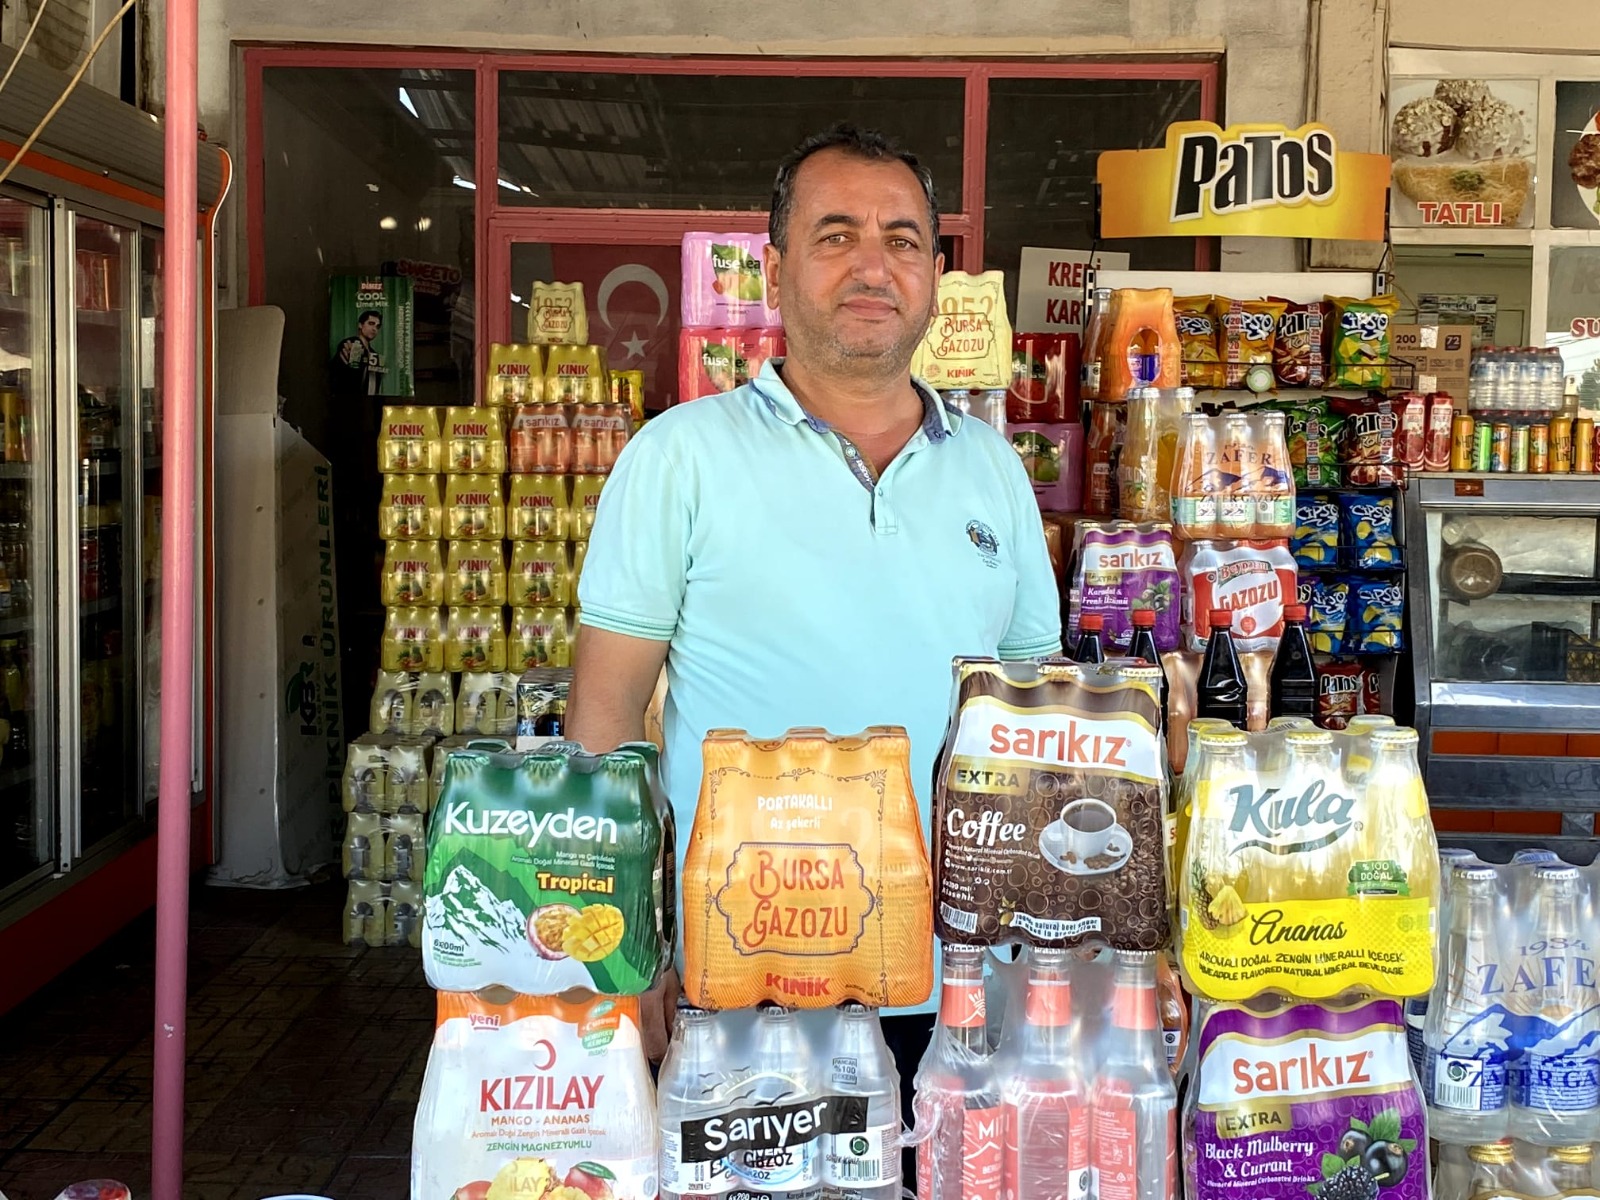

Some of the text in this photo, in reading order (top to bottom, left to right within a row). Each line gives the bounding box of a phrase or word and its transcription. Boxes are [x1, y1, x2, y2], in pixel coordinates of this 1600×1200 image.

[1418, 201, 1502, 225] TATLI
[712, 254, 740, 270] fuse
[1048, 257, 1104, 288] KRE
[357, 292, 386, 301] COOL
[1046, 299, 1084, 325] KAR
[940, 317, 983, 338] BURSA
[937, 338, 985, 357] GAZOZU
[1395, 334, 1460, 345] 200 72
[369, 353, 378, 366] 5
[497, 364, 531, 376] KINIK
[557, 364, 589, 376] KINIK
[947, 368, 977, 378] KINIK
[389, 424, 425, 437] KINIK
[453, 423, 488, 436] KINIK
[1206, 450, 1272, 465] ZAFER
[391, 494, 426, 506] KINIK
[456, 493, 491, 506] KINIK
[521, 495, 554, 507] KINIK
[313, 465, 337, 658] ÜRÜNLERİ
[394, 560, 429, 573] KINIK
[458, 560, 492, 572] KINIK
[522, 561, 556, 573] KINIK
[1218, 580, 1279, 611] GAZOZU
[989, 720, 1126, 767] sarıkız
[957, 769, 1020, 788] EXTRA
[757, 793, 833, 812] PORTAKALLI
[1228, 779, 1356, 839] Kula
[445, 801, 618, 848] Kuzeyden
[770, 817, 784, 830] Az
[946, 808, 1026, 846] Coffee
[750, 850, 845, 899] BURSA
[1361, 870, 1393, 881] DOĞAL
[1371, 861, 1390, 871] 100
[536, 872, 615, 896] Tropical
[742, 899, 848, 949] GAZOZU
[1249, 909, 1347, 946] Ananas
[1241, 953, 1272, 968] DOĞAL
[1199, 963, 1238, 981] PINEAPPLE
[1241, 966, 1282, 980] FLAVORED
[1283, 967, 1323, 978] NATURAL
[1359, 961, 1404, 976] BEVERAGE
[766, 972, 831, 998] KINIK
[468, 1012, 499, 1027] yeni
[833, 1065, 856, 1075] %100
[1232, 1043, 1371, 1095] sarıkız
[480, 1074, 605, 1112] KIZILAY
[491, 1114, 591, 1127] MANGO ANANAS
[703, 1101, 829, 1152] Sarıyer
[1225, 1110, 1282, 1131] EXTRA
[486, 1140, 592, 1153] ZENGİN MAGNEZYUMLU
[1205, 1135, 1314, 1160] Black Mulberry
[1223, 1158, 1294, 1178] & Currant
